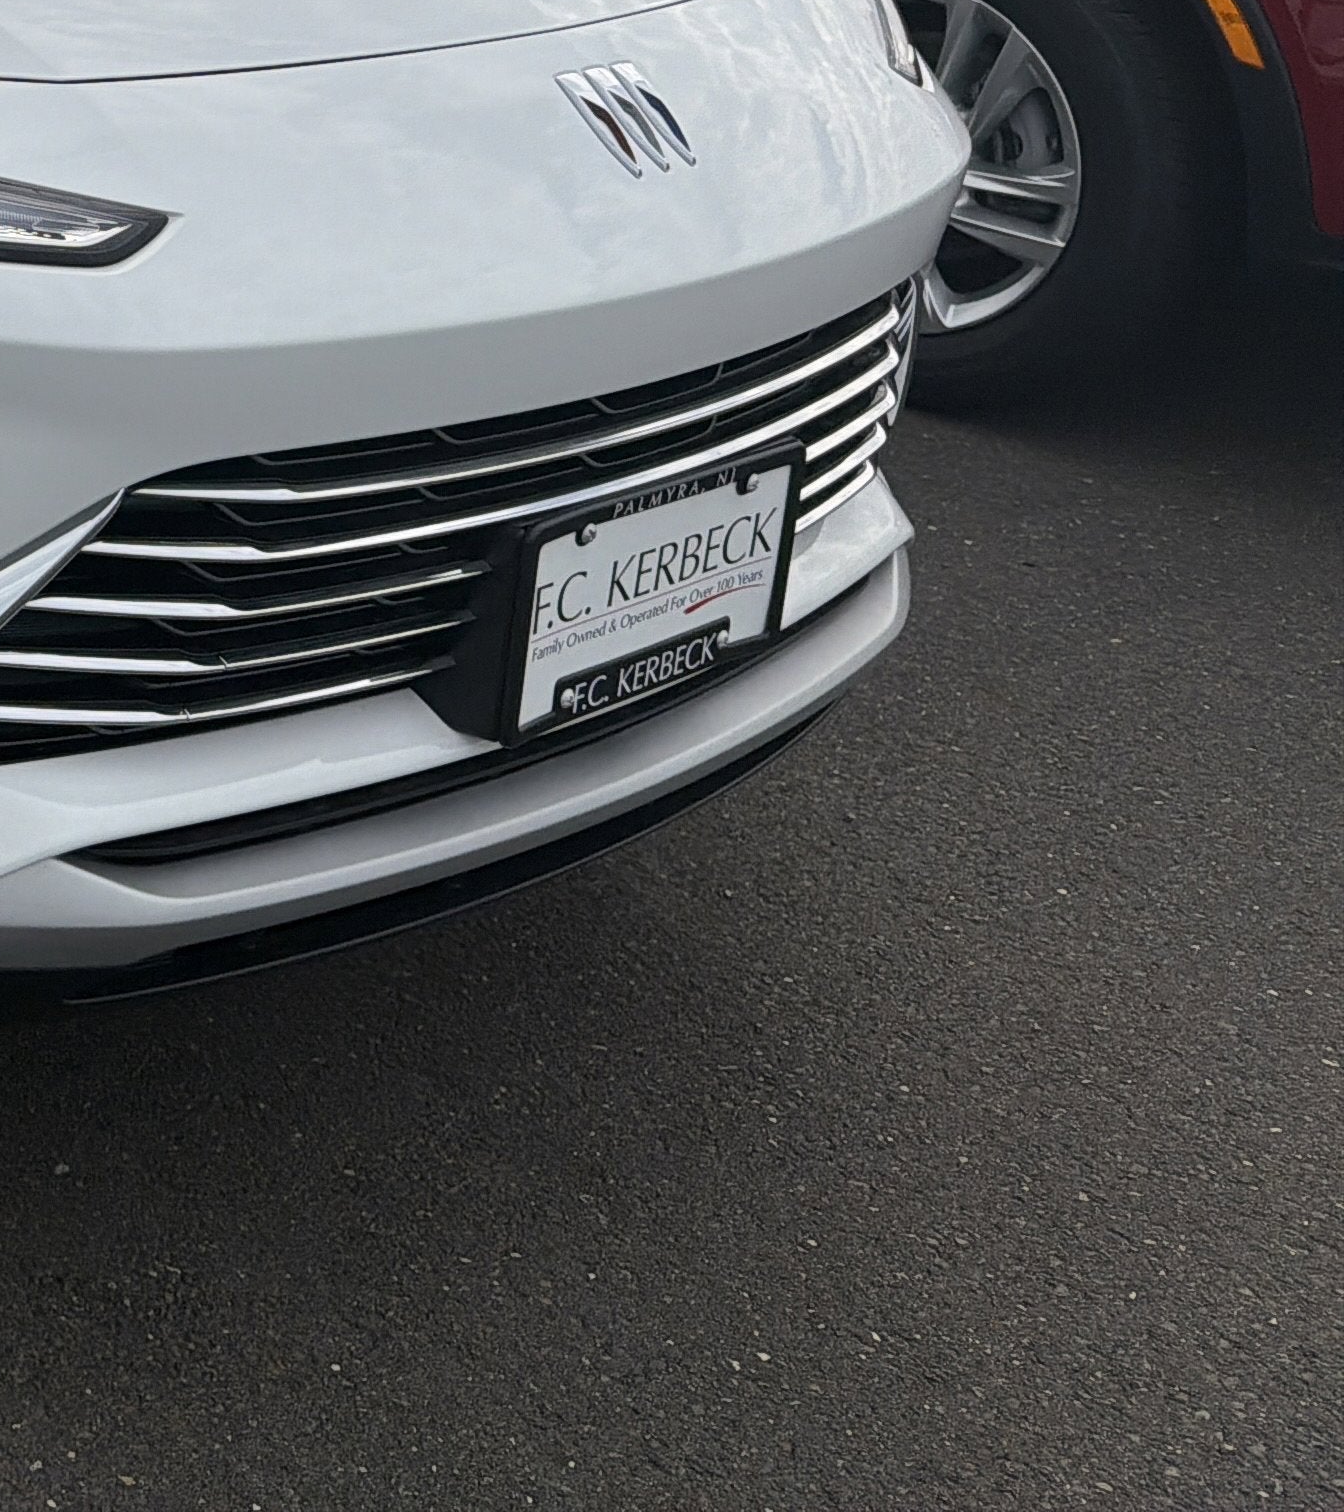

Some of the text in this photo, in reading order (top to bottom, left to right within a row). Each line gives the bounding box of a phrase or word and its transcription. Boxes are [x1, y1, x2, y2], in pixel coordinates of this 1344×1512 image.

[613, 479, 706, 519] PALMYRA,
[532, 506, 778, 635] F.C. KERBECK
[531, 569, 764, 663] Family Owned & Operated For Over 100 Years
[572, 632, 718, 714] F.C. KERBECK
